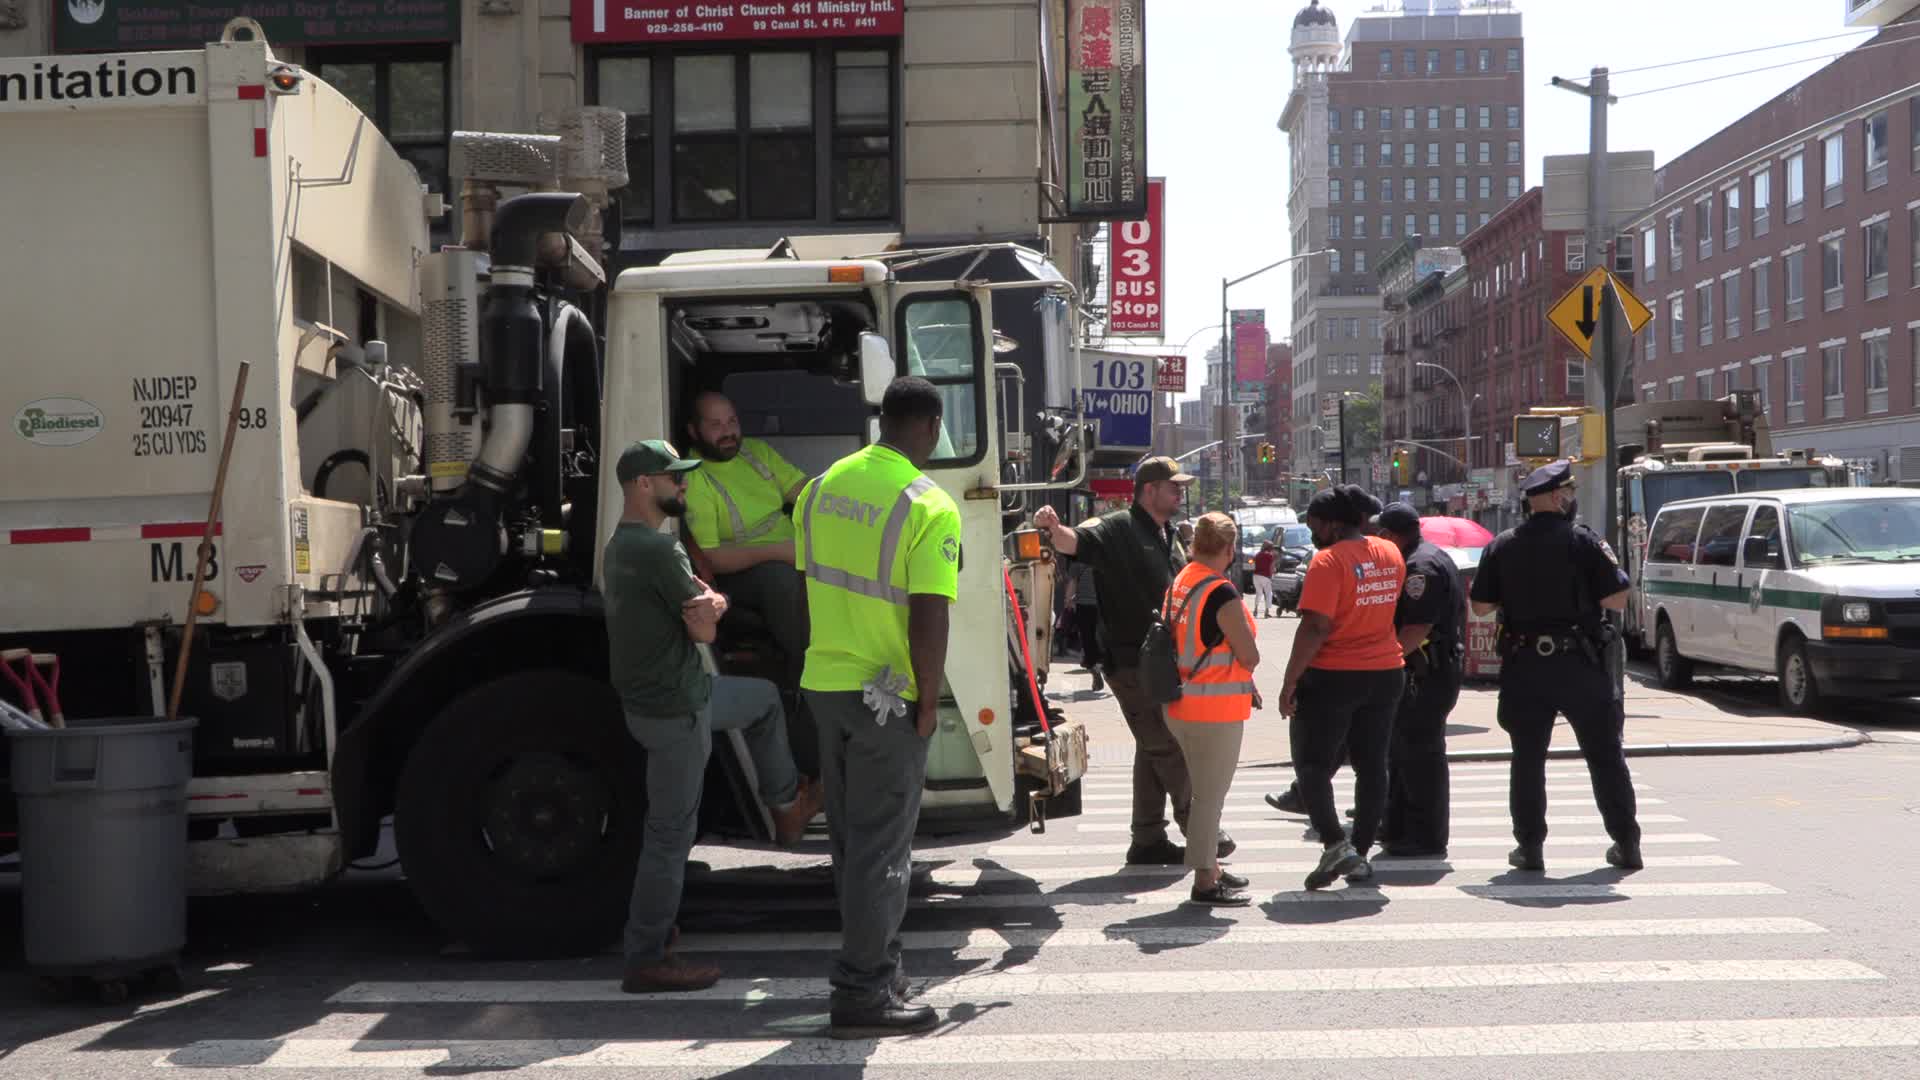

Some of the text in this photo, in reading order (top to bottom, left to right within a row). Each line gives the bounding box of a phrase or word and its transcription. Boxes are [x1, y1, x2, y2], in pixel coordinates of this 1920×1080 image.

[624, 7, 669, 19] Banner
[676, 6, 689, 17] of
[695, 5, 734, 17] Christ
[740, 4, 785, 16] Church
[792, 2, 811, 14] 411
[817, 1, 866, 14] Ministry
[753, 20, 766, 30] 99
[771, 20, 800, 30] Canal
[822, 18, 829, 27] 4
[0, 60, 196, 101] nitation
[1116, 281, 1155, 296] BUS
[1112, 300, 1159, 318] Stop
[1093, 360, 1144, 389] 103
[133, 376, 197, 401] NJDEP
[1110, 393, 1149, 415] OHIO
[31, 415, 99, 430] Biodiesel
[141, 404, 193, 428] 20947
[176, 430, 206, 454] YDS
[818, 493, 884, 528] DSNY
[1357, 580, 1397, 593] HOMELESS
